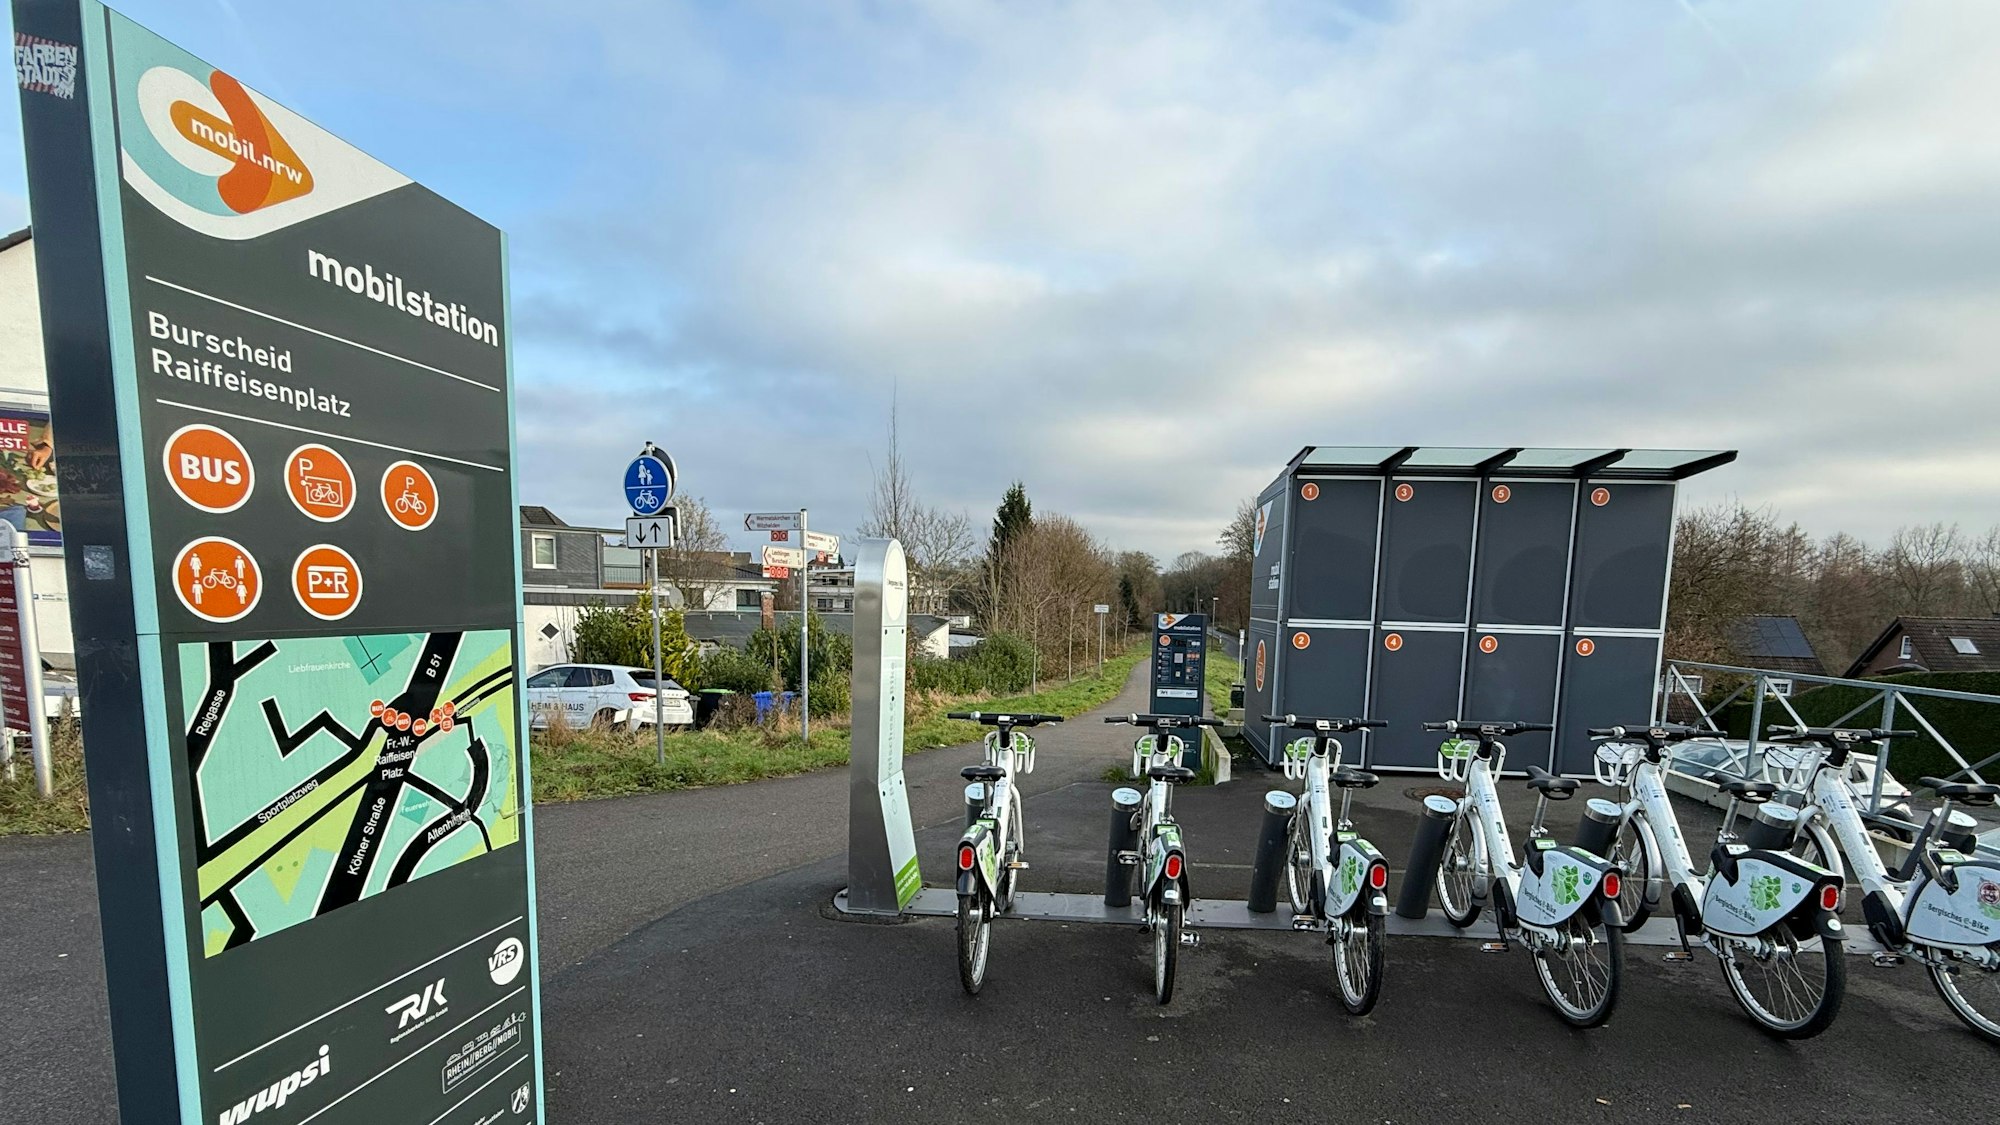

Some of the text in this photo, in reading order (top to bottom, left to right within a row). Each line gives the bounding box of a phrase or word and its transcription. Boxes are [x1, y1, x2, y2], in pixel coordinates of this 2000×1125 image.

[191, 118, 303, 186] mobil.nrw
[308, 248, 498, 347] mobilstation
[148, 311, 292, 374] Burscheid
[152, 348, 352, 418] Raiffeisenplatz
[180, 452, 241, 486] BUS
[1308, 488, 1312, 496] 1
[1402, 488, 1408, 497] 3
[1498, 490, 1504, 498] 5
[1597, 492, 1604, 501] 7
[308, 571, 348, 594] P+R
[1298, 636, 1304, 644] 2
[1390, 638, 1396, 646] 4
[1485, 640, 1491, 648] 6
[1582, 642, 1588, 651] 8
[426, 654, 443, 678] B 51
[196, 689, 226, 737] Reigasse
[562, 703, 585, 711] HAUS
[386, 736, 415, 750] Fr.-W.-
[382, 767, 404, 780] Platz
[257, 778, 320, 825] Sportplatzweg
[347, 797, 386, 875] Kölner Straße
[1928, 903, 1962, 923] Bergisches
[488, 945, 516, 973] VRS
[220, 1044, 330, 1125] wupsi
